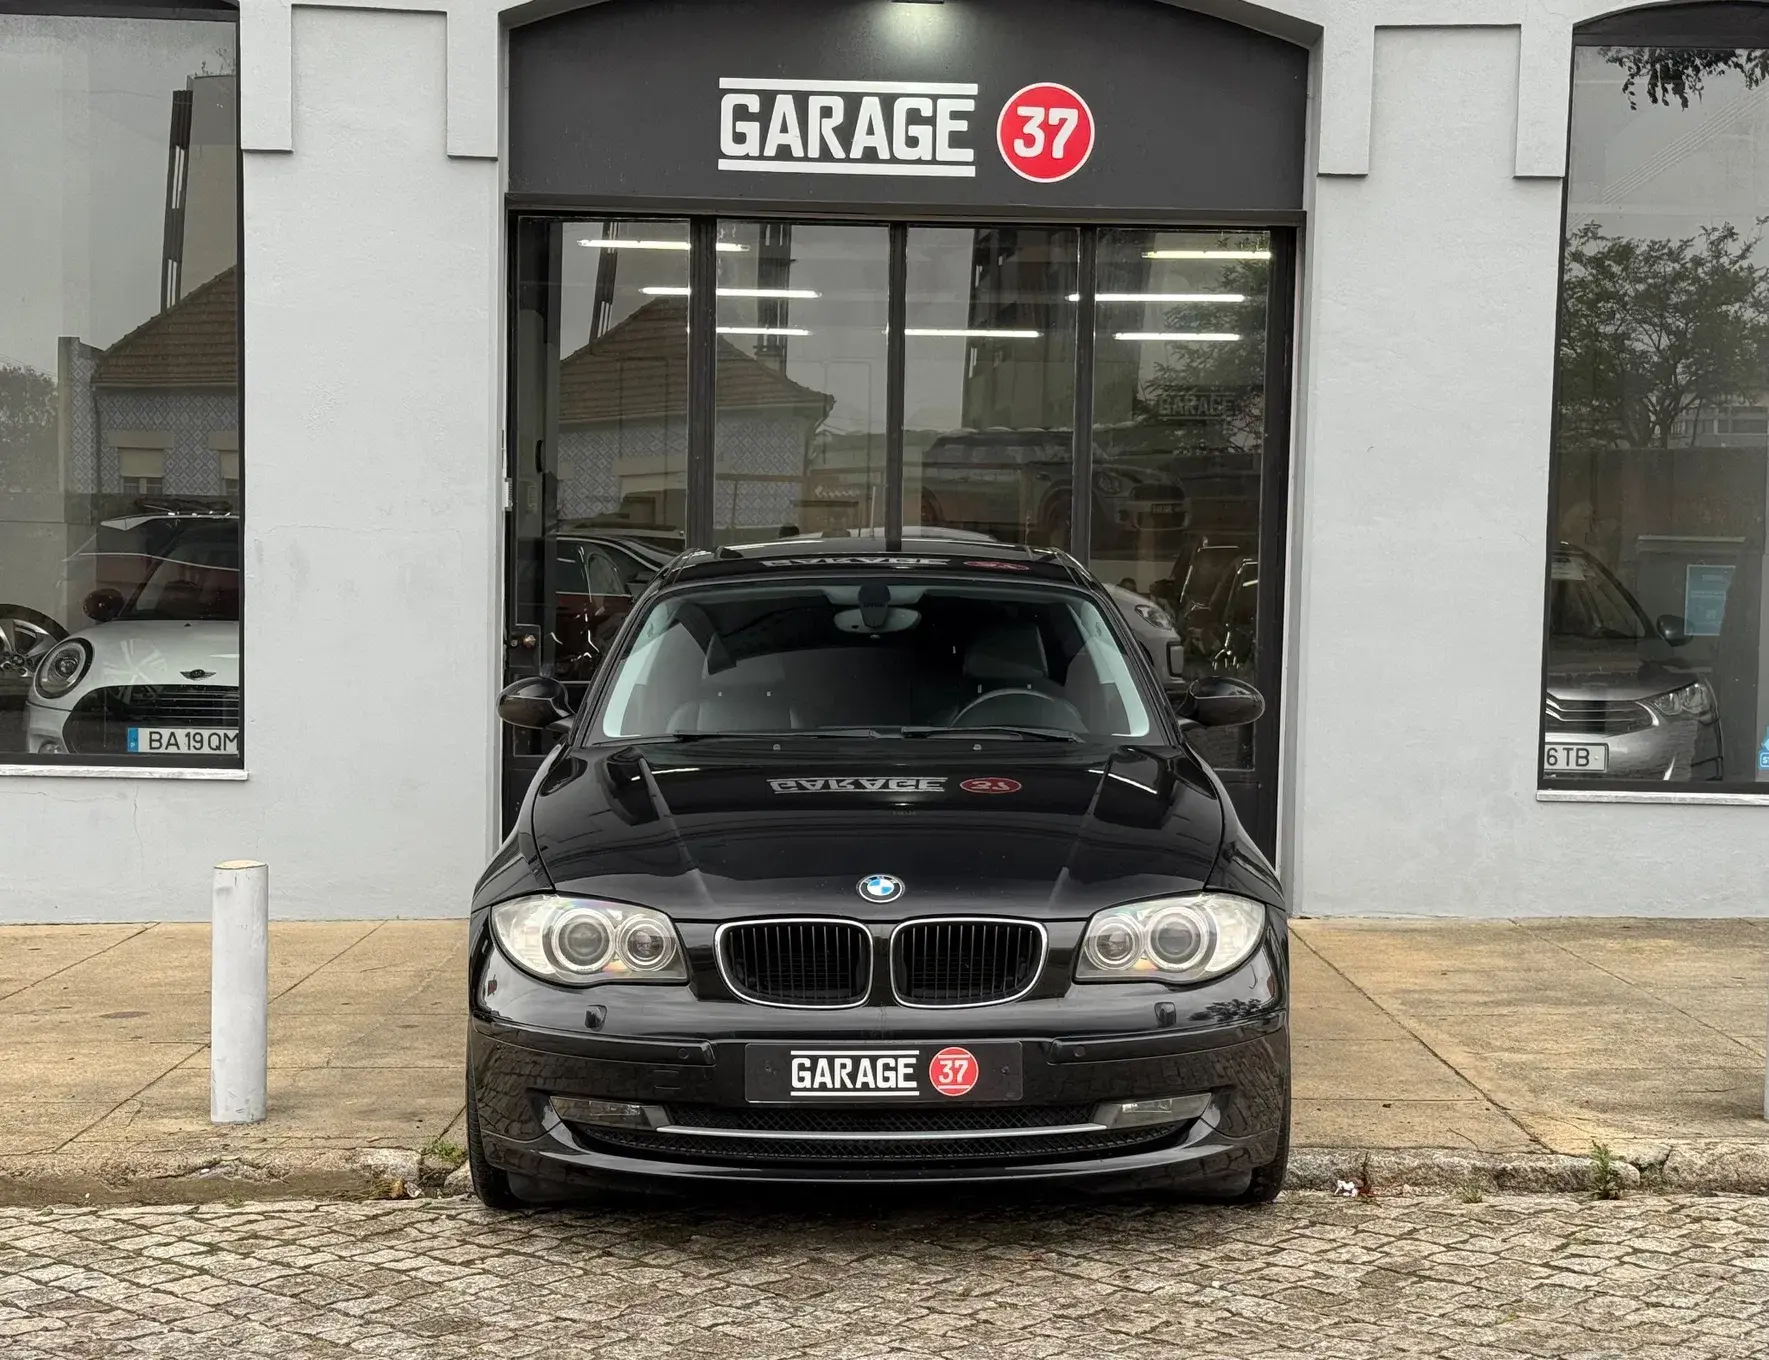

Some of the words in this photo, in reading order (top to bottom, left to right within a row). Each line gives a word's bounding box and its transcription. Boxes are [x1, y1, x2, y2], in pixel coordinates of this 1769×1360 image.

[720, 93, 975, 161] GARAGE
[1013, 106, 1079, 159] 37
[791, 1057, 917, 1089] GARAGE
[938, 1060, 969, 1084] 37
